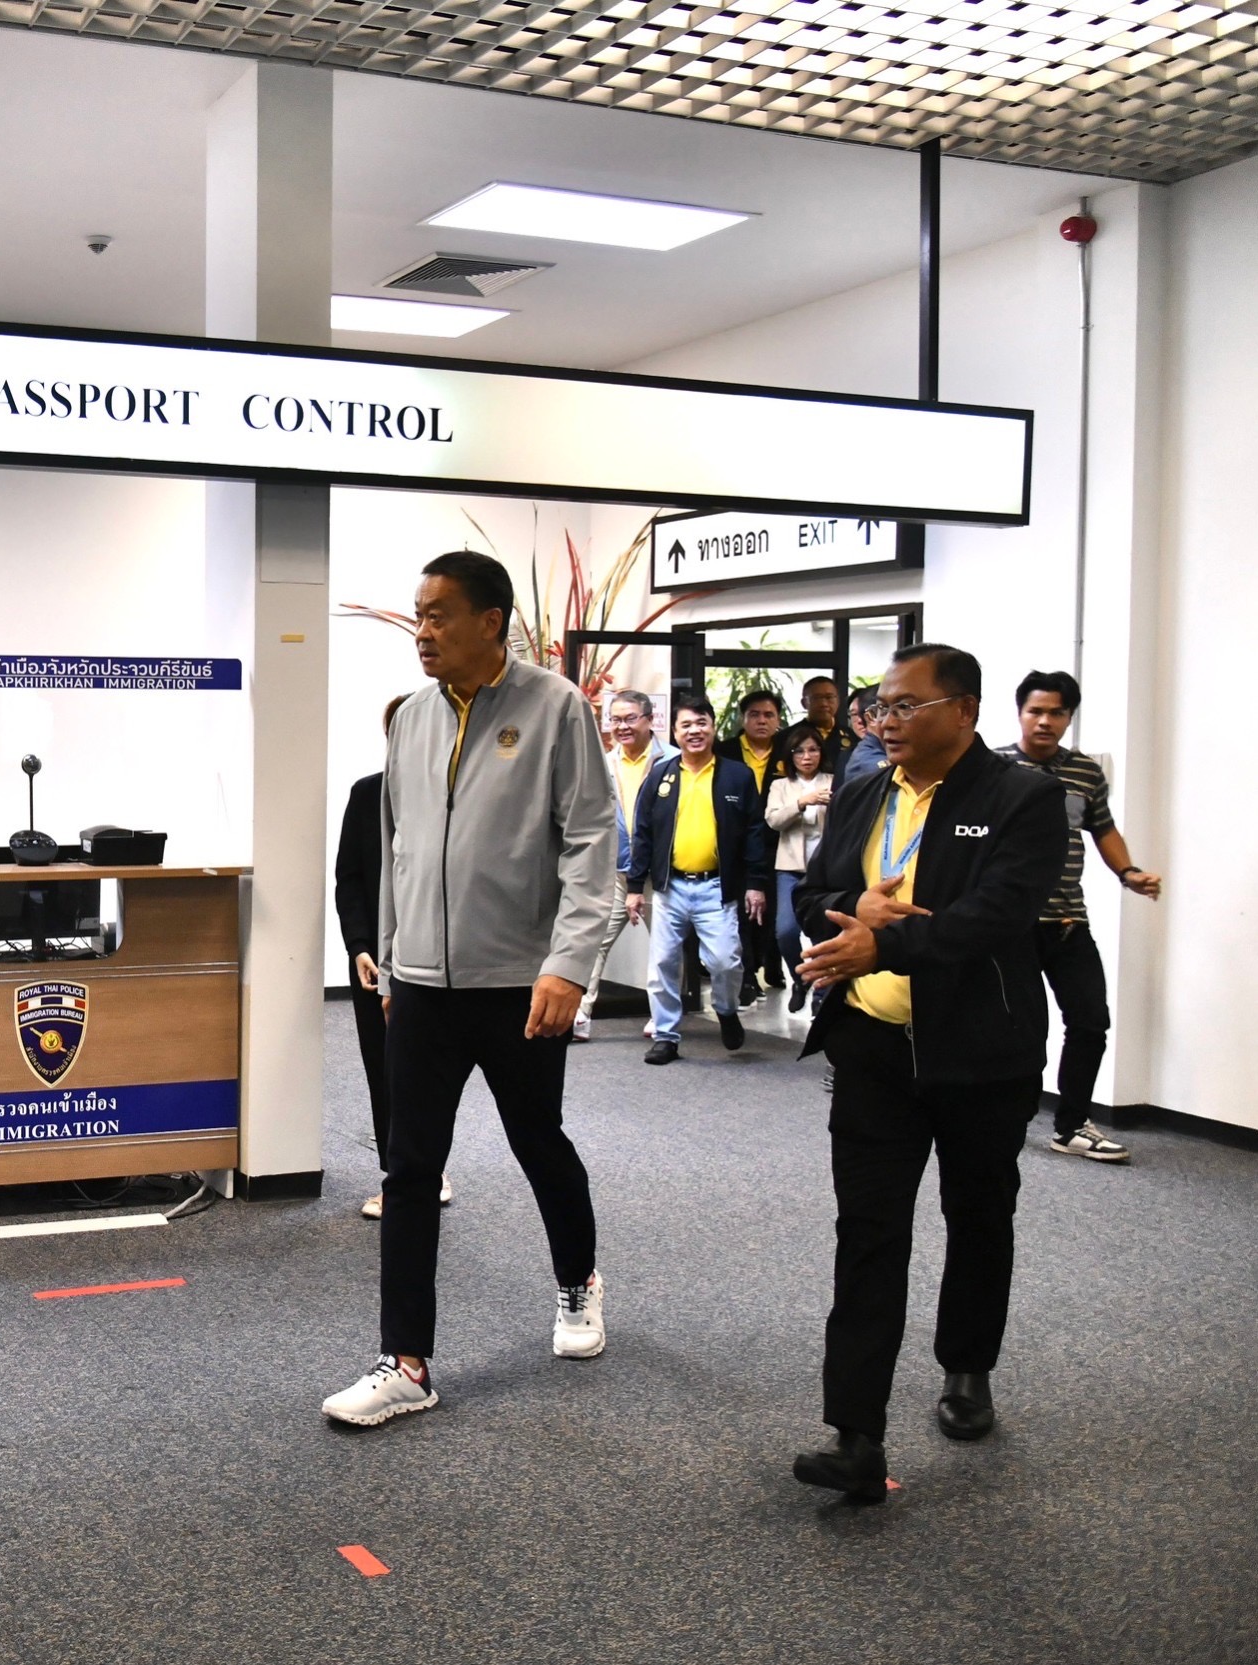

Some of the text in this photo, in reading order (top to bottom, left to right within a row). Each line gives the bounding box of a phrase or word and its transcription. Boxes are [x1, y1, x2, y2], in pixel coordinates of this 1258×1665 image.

[242, 393, 453, 443] CONTROL
[798, 519, 838, 548] EXIT
[697, 529, 769, 561] ทางออก
[104, 678, 196, 689] IMMIGRATION
[955, 825, 989, 837] DOA
[19, 985, 84, 999] ROYAL THAI POLICE
[20, 1009, 83, 1022] IMMIGRATION BUREAU
